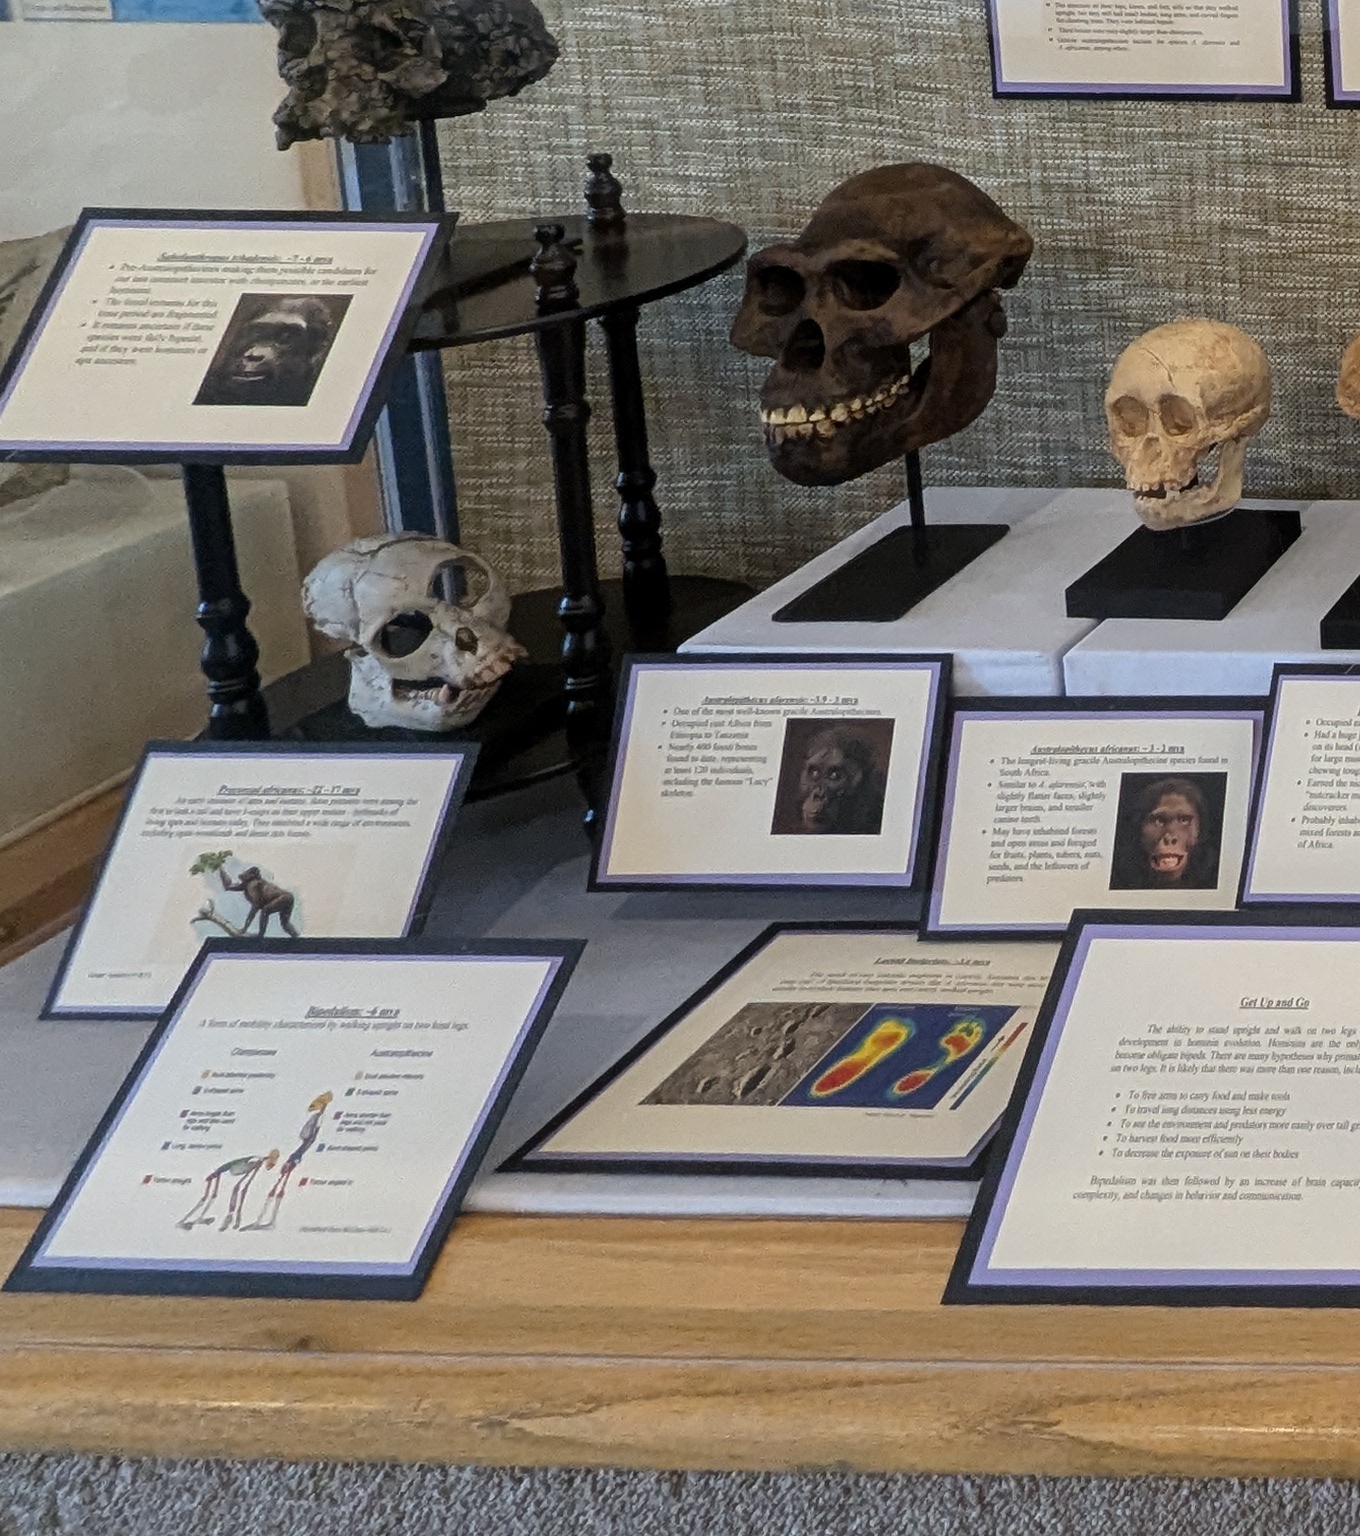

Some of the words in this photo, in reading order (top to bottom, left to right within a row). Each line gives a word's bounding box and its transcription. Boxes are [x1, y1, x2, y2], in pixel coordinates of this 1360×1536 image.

[1240, 996, 1258, 1009] Get
[1260, 996, 1273, 1009] Up
[1276, 996, 1293, 1009] and
[1296, 997, 1310, 1010] Go
